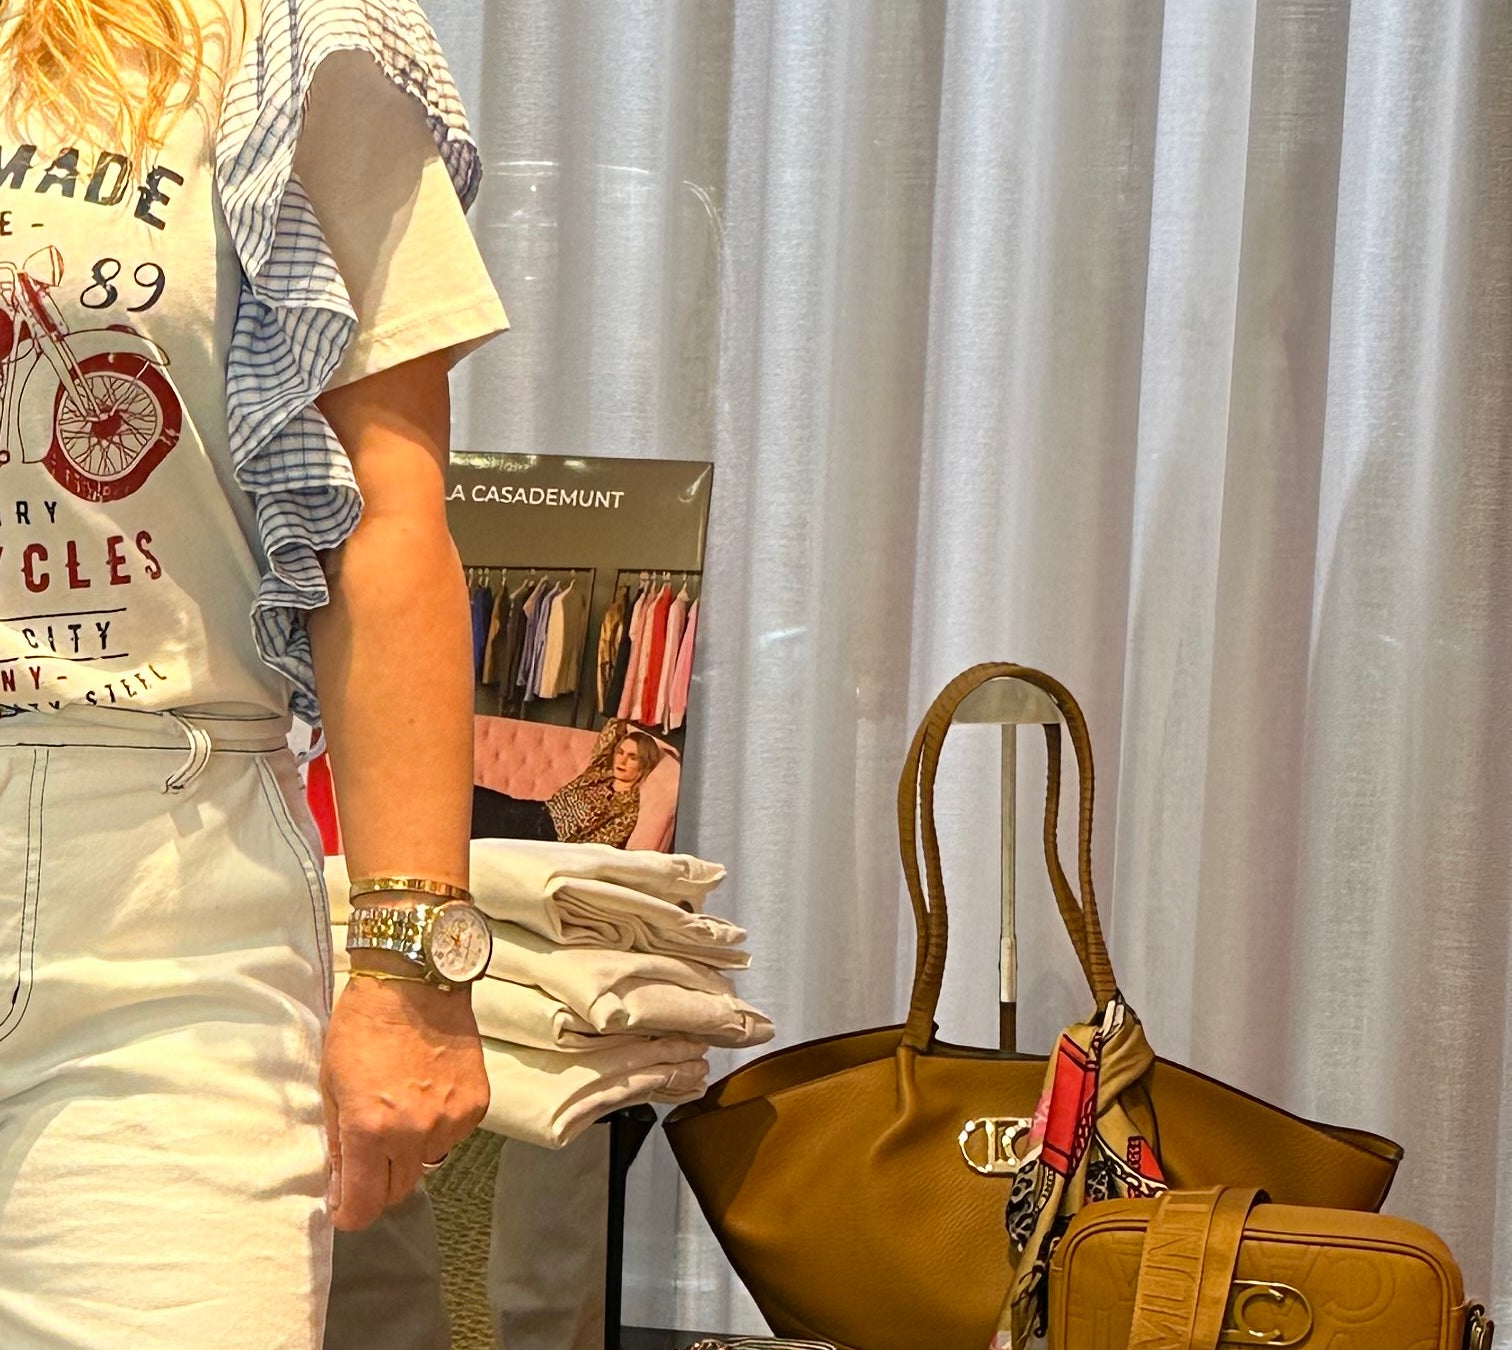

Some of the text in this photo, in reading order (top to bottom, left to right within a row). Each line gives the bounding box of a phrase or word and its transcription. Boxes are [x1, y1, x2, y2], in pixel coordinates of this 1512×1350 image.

[79, 257, 166, 313] 89
[471, 484, 625, 509] CASADEMUNT
[21, 620, 111, 654] CITY
